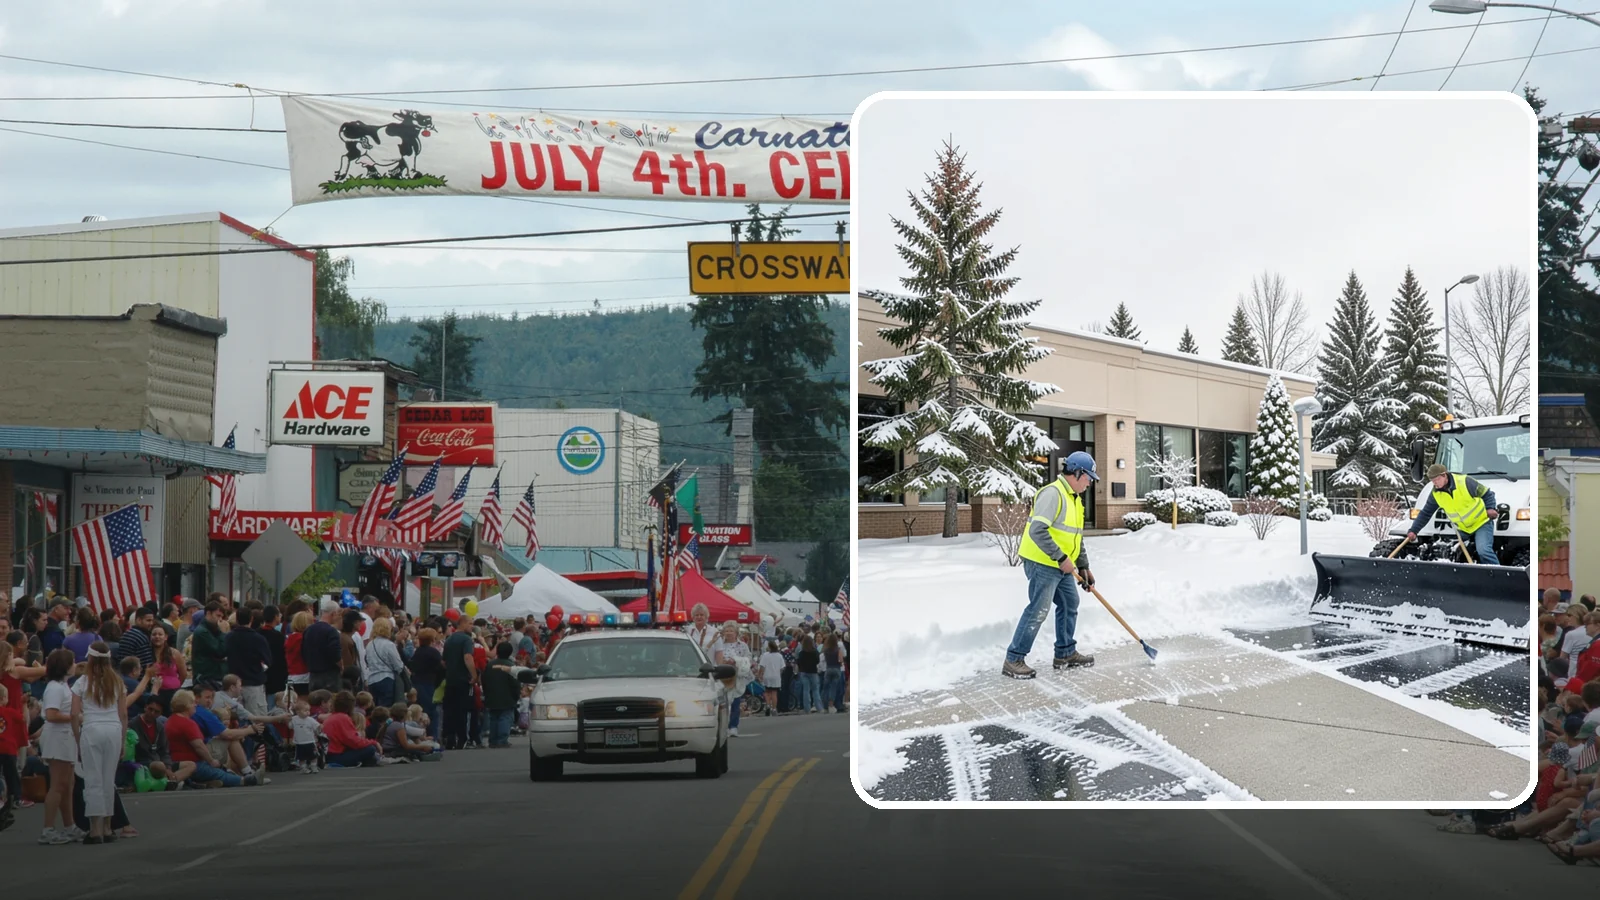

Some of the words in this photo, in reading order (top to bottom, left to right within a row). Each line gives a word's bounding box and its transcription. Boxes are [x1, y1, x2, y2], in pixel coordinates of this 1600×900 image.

[481, 141, 605, 192] JULY
[632, 150, 746, 198] 4th.
[697, 254, 850, 280] CROSSWA
[283, 380, 373, 420] ACE
[405, 409, 453, 422] CEDAR
[283, 421, 371, 436] Hardware
[416, 428, 477, 447] Coca-Cola
[96, 485, 124, 495] Vincent
[126, 486, 136, 495] de
[138, 486, 155, 495] Paul
[688, 526, 741, 535] CRNATION
[699, 535, 730, 543] GLASS
